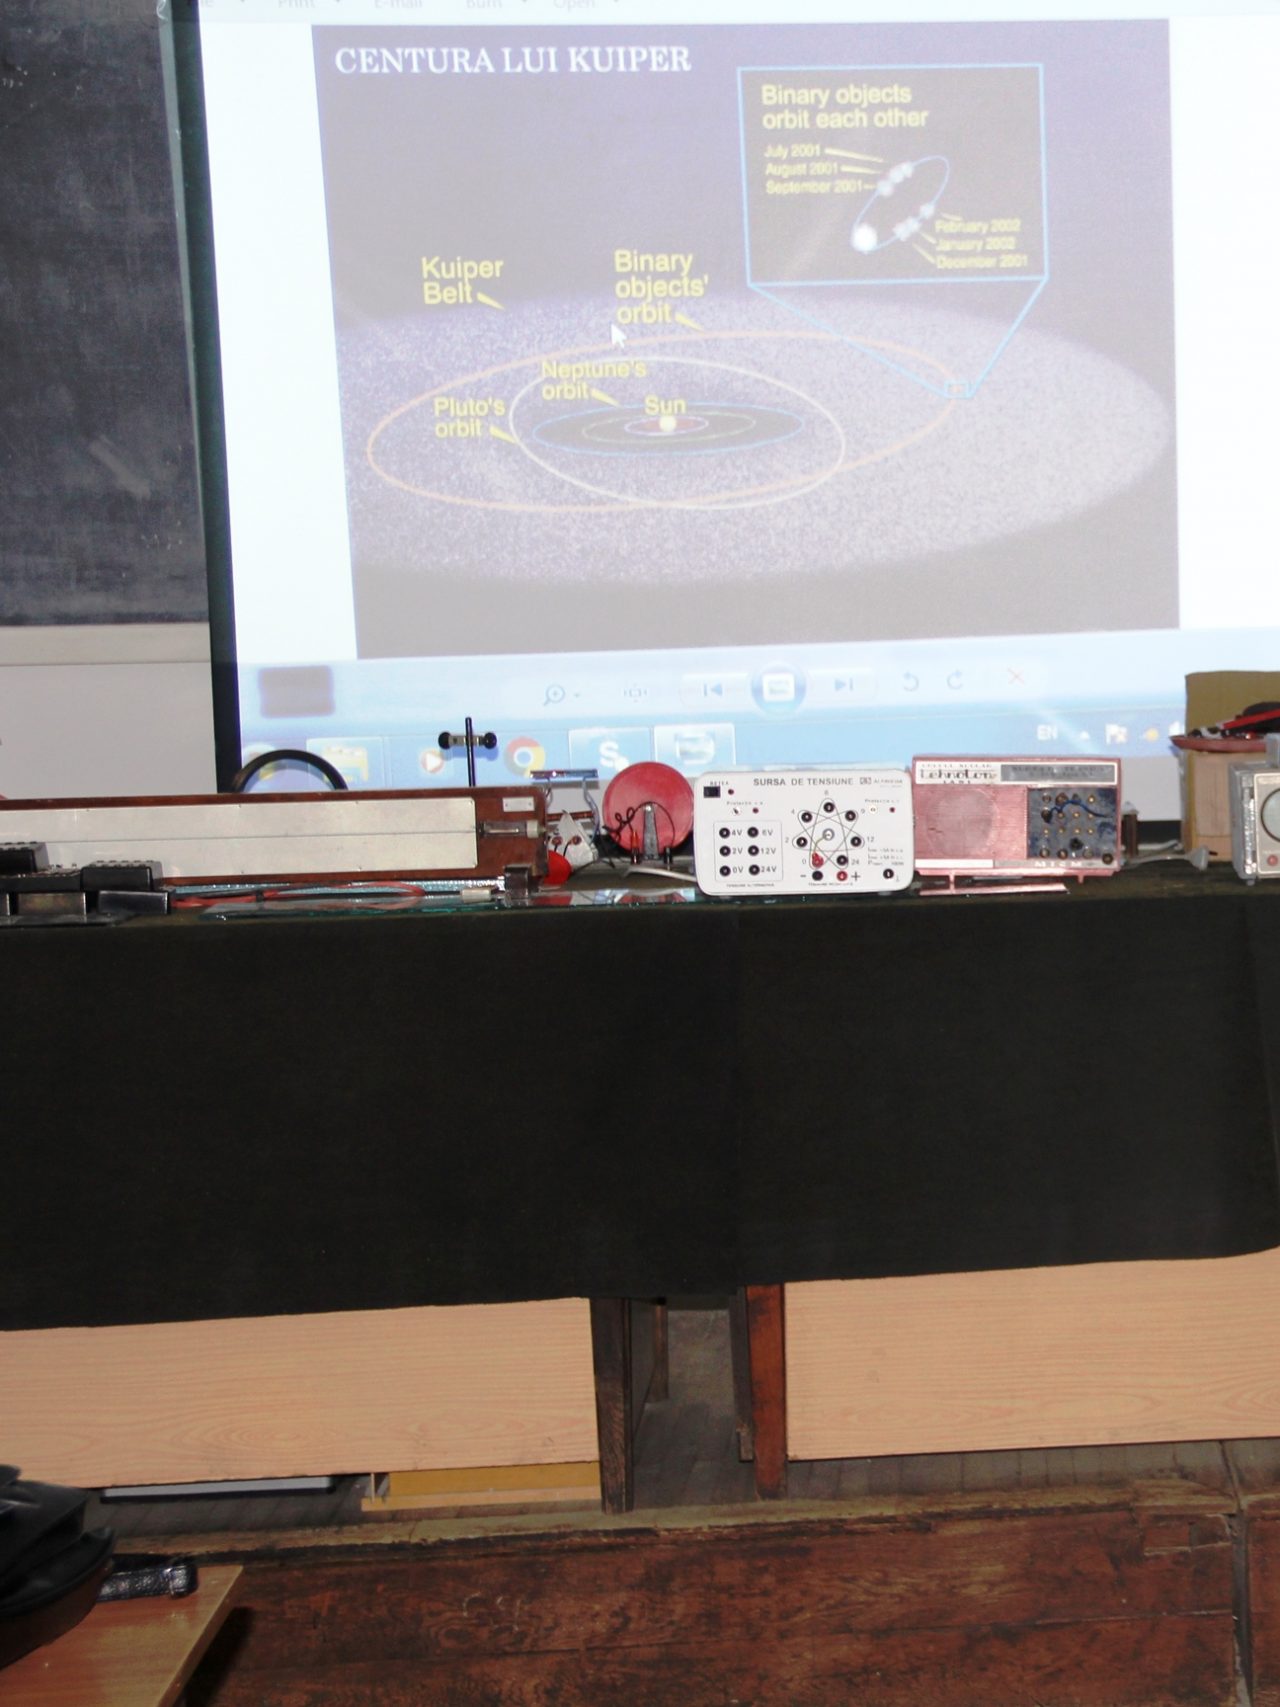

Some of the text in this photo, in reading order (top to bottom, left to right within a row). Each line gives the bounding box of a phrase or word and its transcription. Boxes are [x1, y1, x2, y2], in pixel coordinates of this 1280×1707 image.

[334, 45, 692, 75] CENTURA LUI KUIPER
[760, 83, 913, 108] Binary objects
[761, 107, 930, 130] orbit each other
[763, 143, 821, 160] July 2001
[765, 160, 839, 178] August 2001
[765, 178, 863, 195] September 2001
[934, 218, 989, 234] February
[935, 237, 984, 253] January
[421, 256, 504, 285] Kuiper
[613, 249, 693, 278] Binary
[936, 254, 998, 269] December
[423, 281, 476, 304] Belt
[614, 274, 709, 301] objects'
[617, 303, 673, 325] orbit
[541, 360, 647, 382] Neptune's
[541, 382, 590, 400] orbit
[434, 396, 506, 417] Pluto's
[644, 394, 686, 415] Sun
[434, 419, 482, 438] orbit
[753, 776, 854, 787] SURSA DE TENSIUNE
[760, 847, 777, 855] 12V
